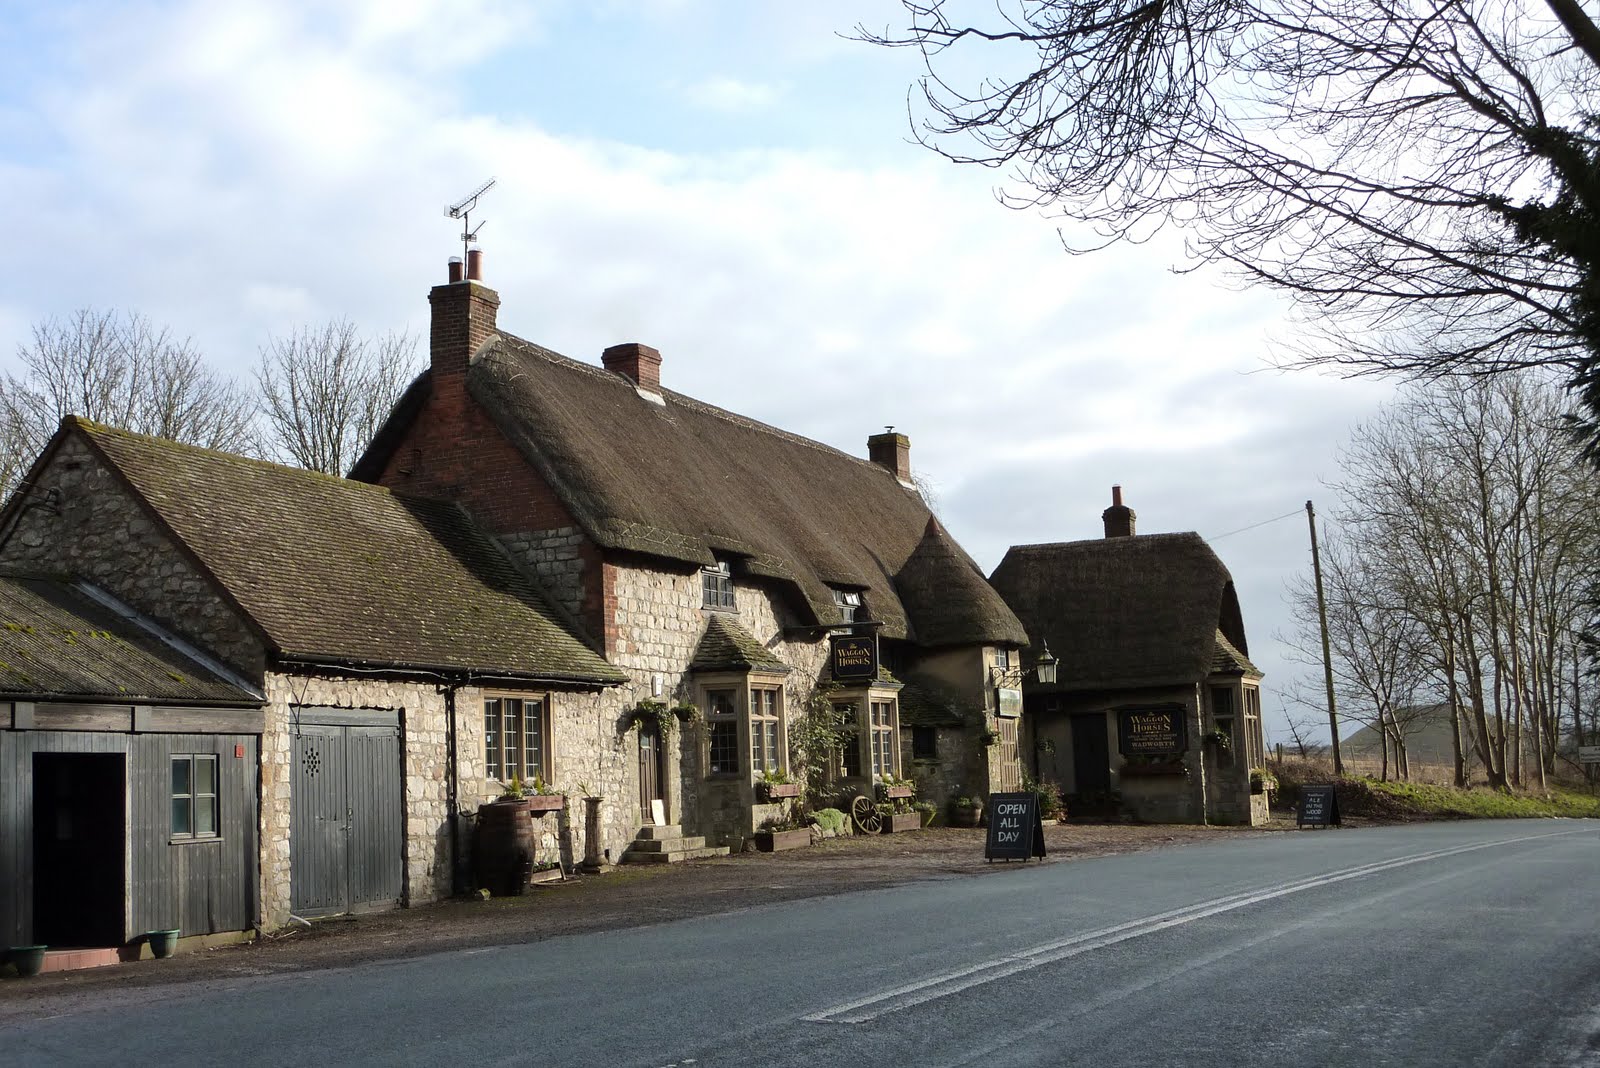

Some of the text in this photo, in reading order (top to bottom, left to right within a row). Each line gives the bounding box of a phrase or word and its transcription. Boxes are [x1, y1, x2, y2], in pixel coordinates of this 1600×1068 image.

[838, 648, 870, 657] WAGGON
[840, 657, 870, 667] HORSES
[1130, 714, 1171, 724] WAGGON
[1133, 723, 1171, 733] HORSES
[997, 804, 1027, 815] OPEN
[1000, 817, 1020, 828] ALL
[998, 831, 1020, 842] DAY
